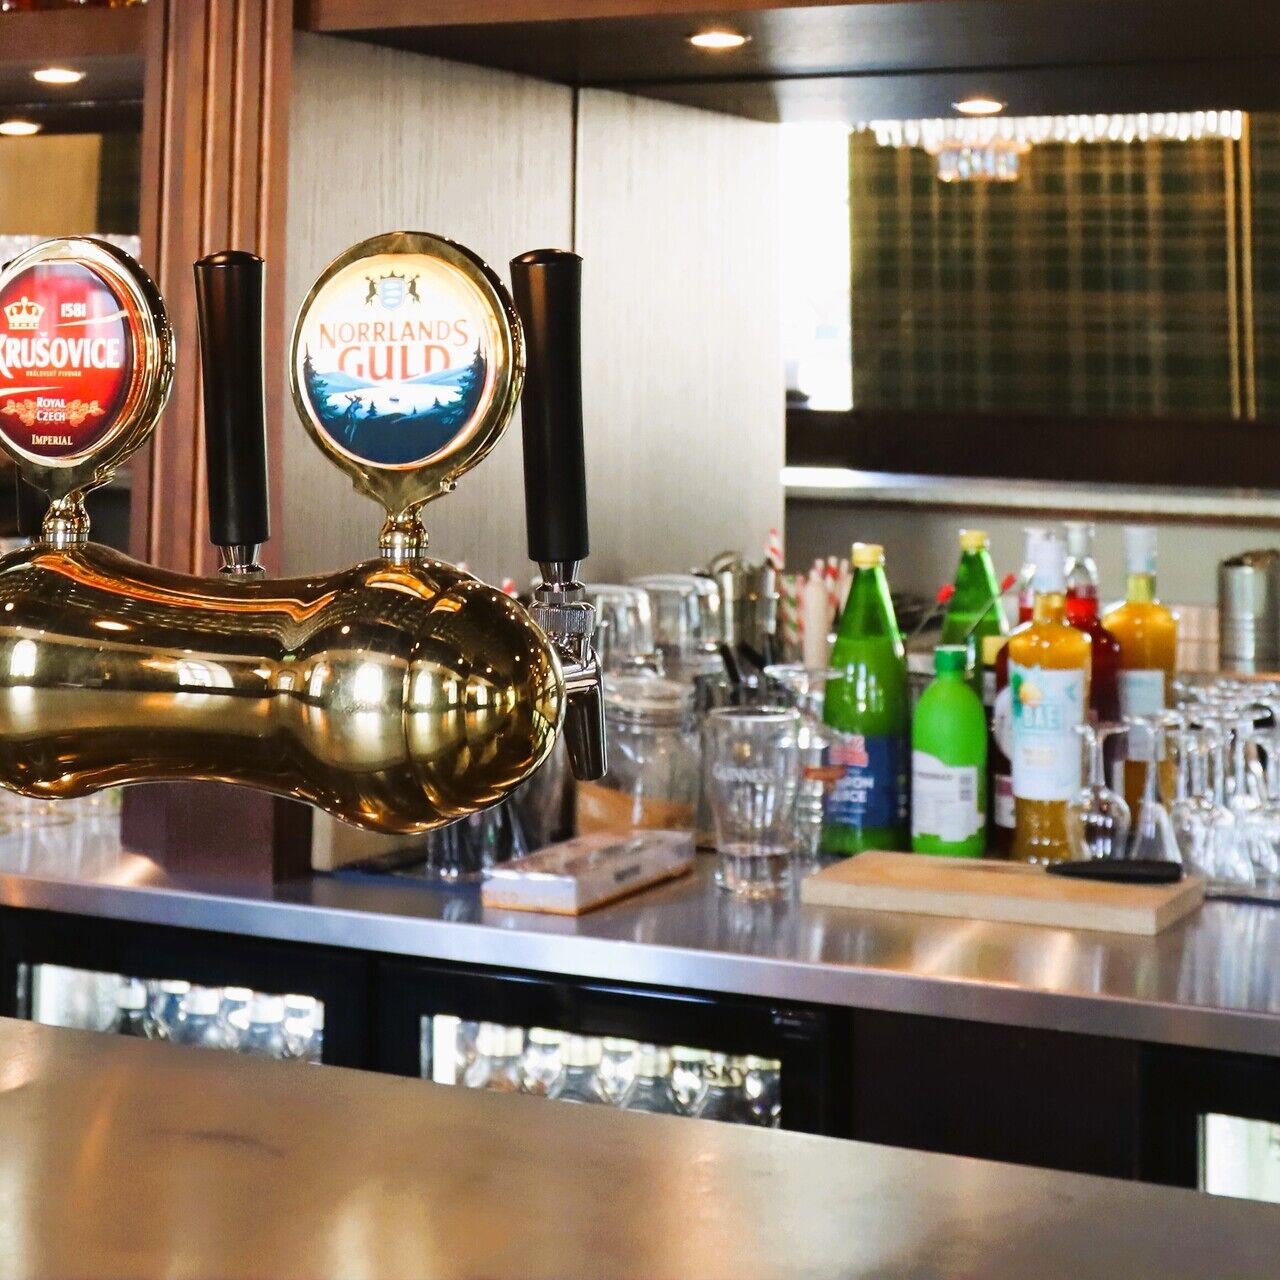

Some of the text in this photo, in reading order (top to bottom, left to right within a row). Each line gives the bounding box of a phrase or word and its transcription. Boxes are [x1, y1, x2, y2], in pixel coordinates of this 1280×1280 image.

[60, 303, 87, 318] 1581
[320, 319, 468, 349] NORRLANDS
[337, 344, 451, 381] GULD
[36, 397, 66, 408] ROYAL
[36, 410, 66, 421] CZECH
[31, 434, 73, 445] IMPERIAL
